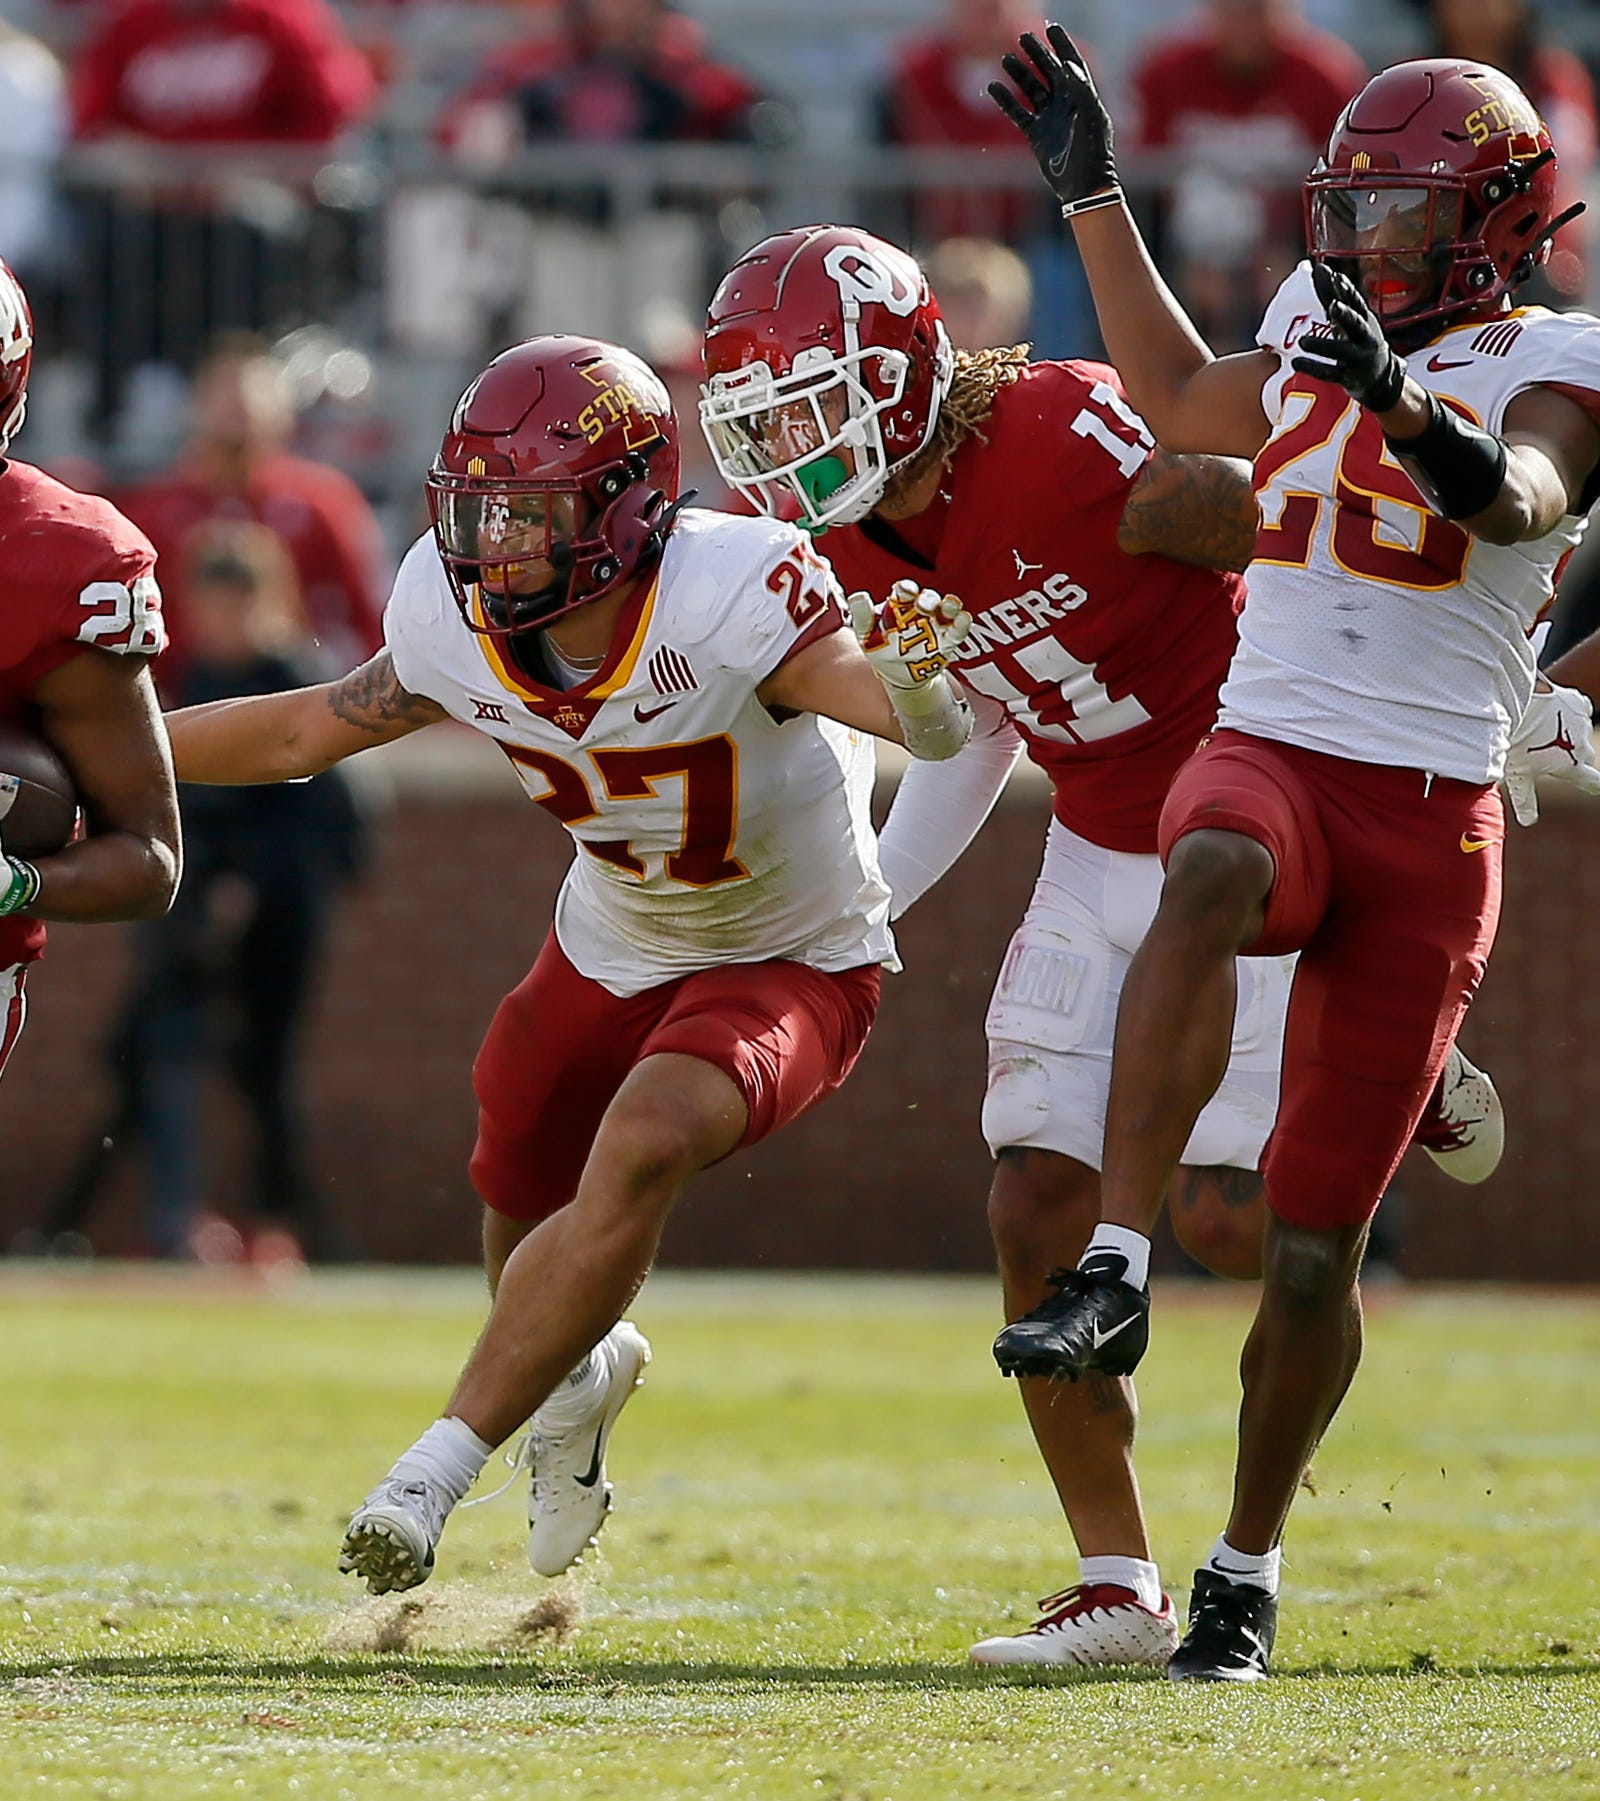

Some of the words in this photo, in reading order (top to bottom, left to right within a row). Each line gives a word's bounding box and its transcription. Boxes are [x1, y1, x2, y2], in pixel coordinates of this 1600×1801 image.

[1283, 313, 1312, 350] C
[1069, 380, 1157, 479] 11
[468, 698, 512, 726] XII
[957, 634, 1153, 745] 11
[492, 731, 753, 890] 27
